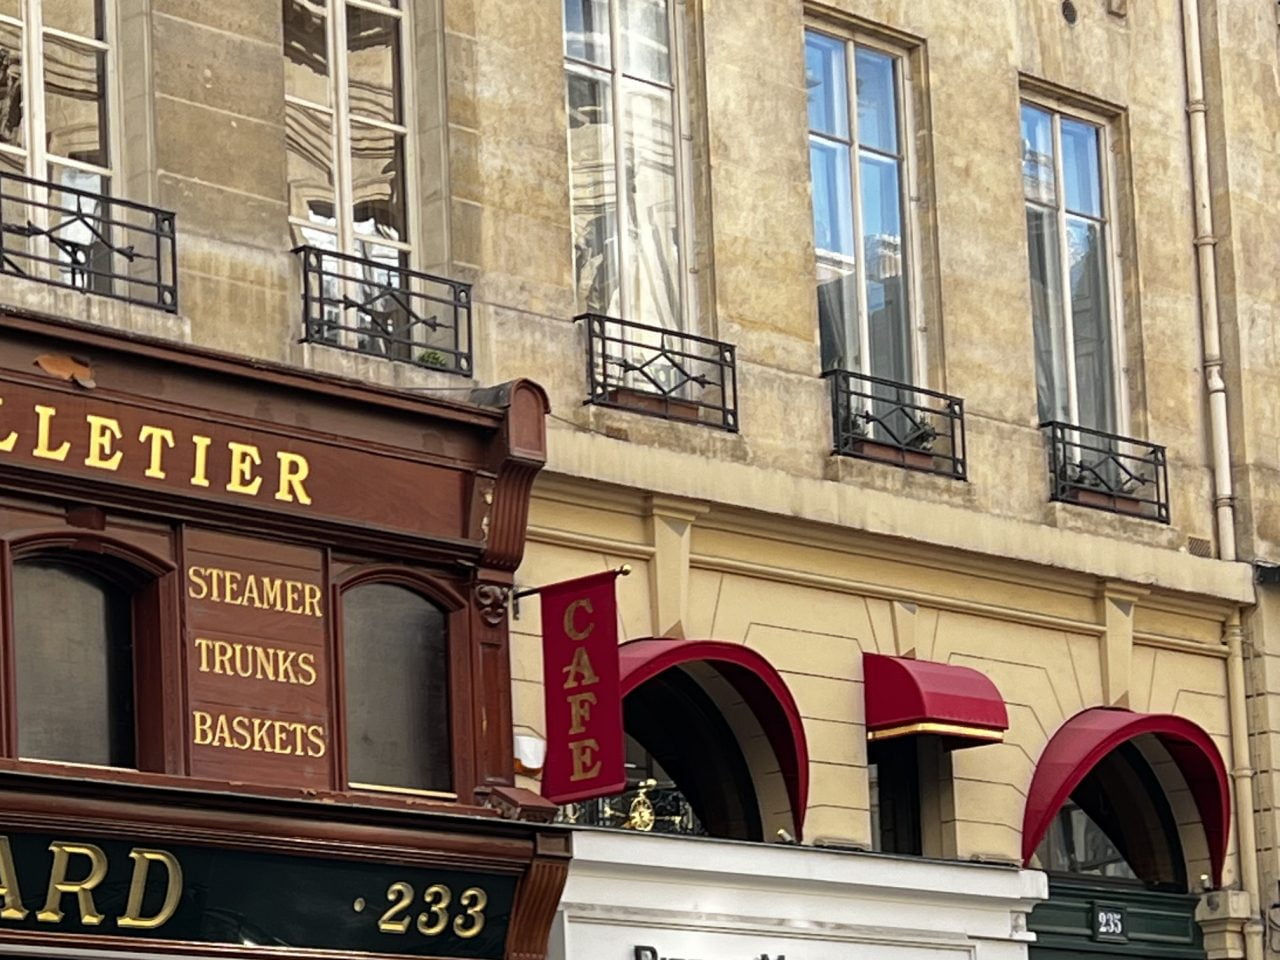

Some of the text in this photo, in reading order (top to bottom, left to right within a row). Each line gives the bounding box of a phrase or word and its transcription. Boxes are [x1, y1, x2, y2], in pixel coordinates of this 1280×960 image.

[187, 565, 324, 618] STEAMER
[194, 637, 317, 687] TRUNKS
[562, 597, 602, 783] CAFE
[193, 711, 327, 758] BASKETS
[378, 881, 489, 940] 233
[1098, 911, 1122, 934] 235
